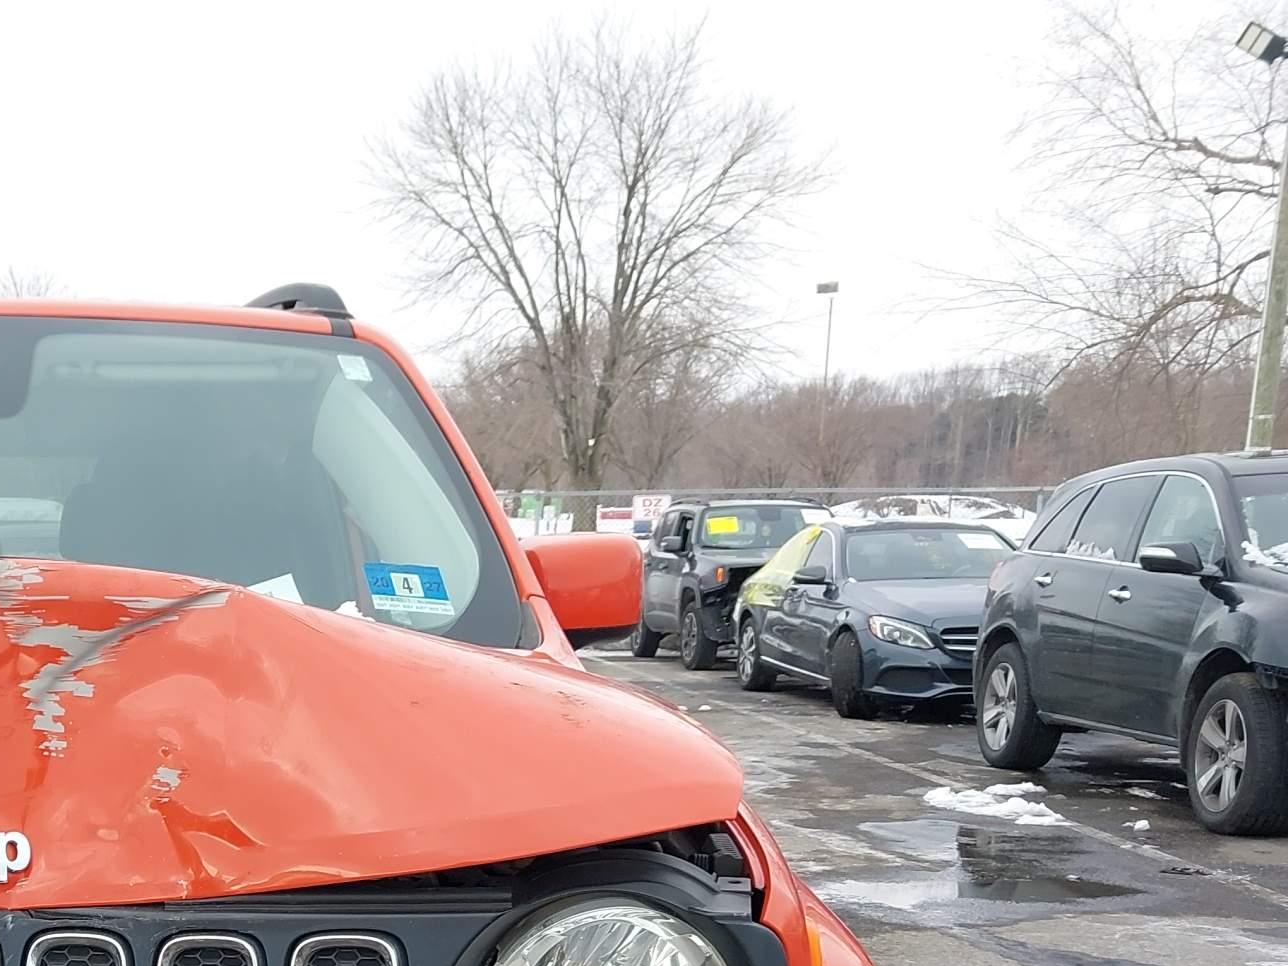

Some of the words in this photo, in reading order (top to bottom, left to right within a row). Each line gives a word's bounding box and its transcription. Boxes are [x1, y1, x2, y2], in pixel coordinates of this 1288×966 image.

[643, 498, 662, 507] DZ
[371, 576, 390, 588] 20
[402, 577, 414, 594] 4
[423, 581, 442, 592] 27
